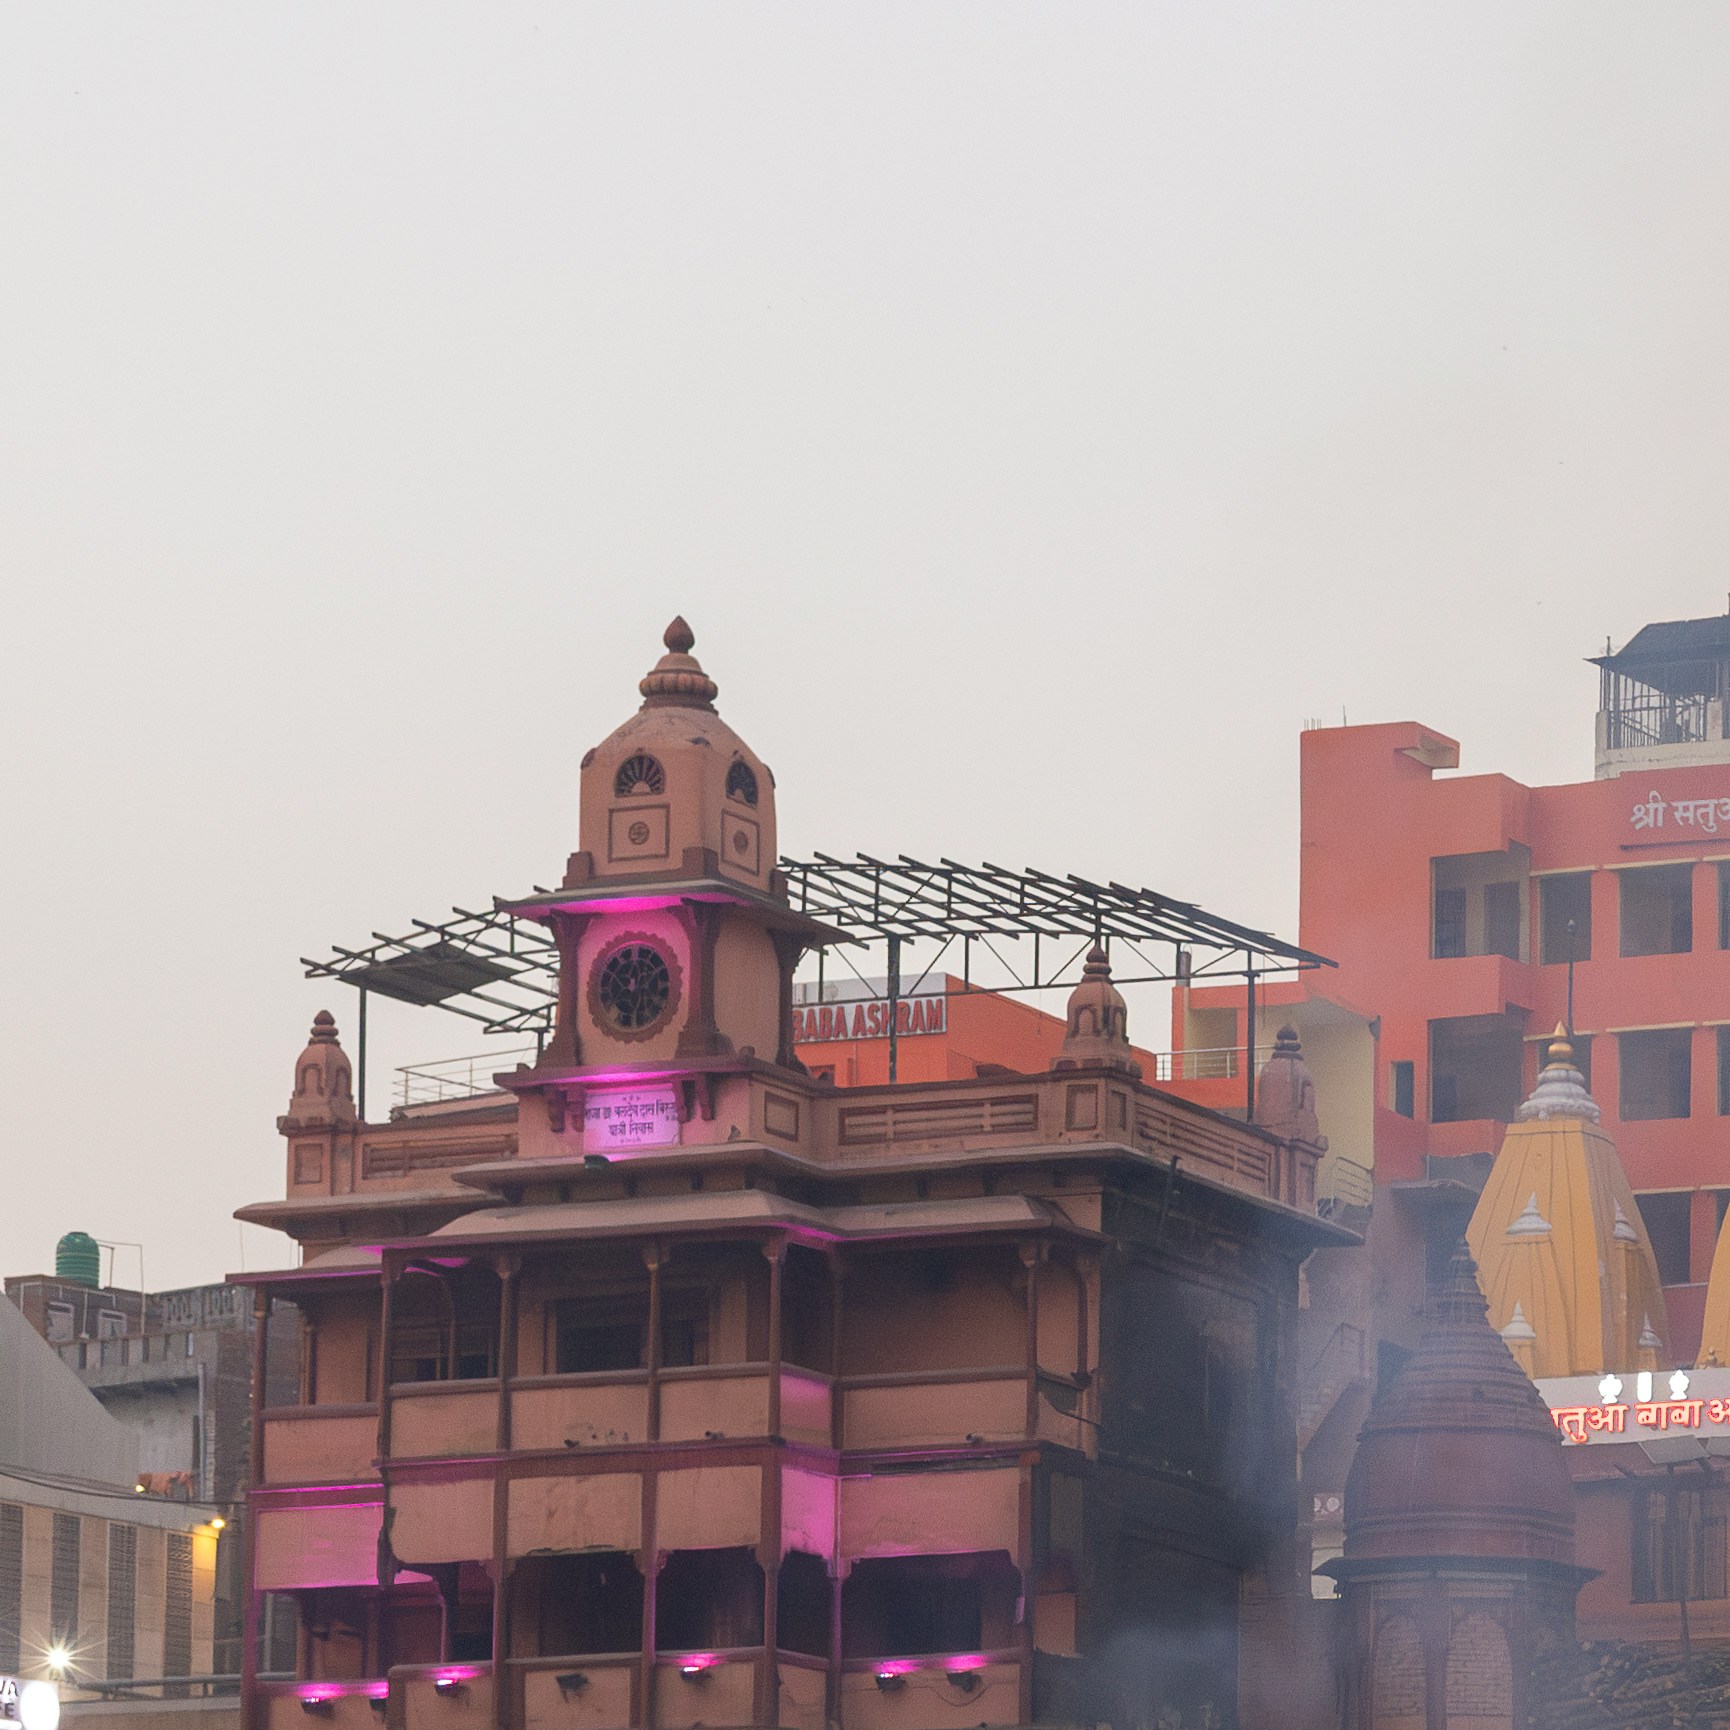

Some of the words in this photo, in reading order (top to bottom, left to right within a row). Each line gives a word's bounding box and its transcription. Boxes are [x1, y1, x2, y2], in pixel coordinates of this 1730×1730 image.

[1630, 789, 1667, 830] श्री
[793, 1005, 848, 1042] BABA
[1634, 1401, 1704, 1431] बाबा
